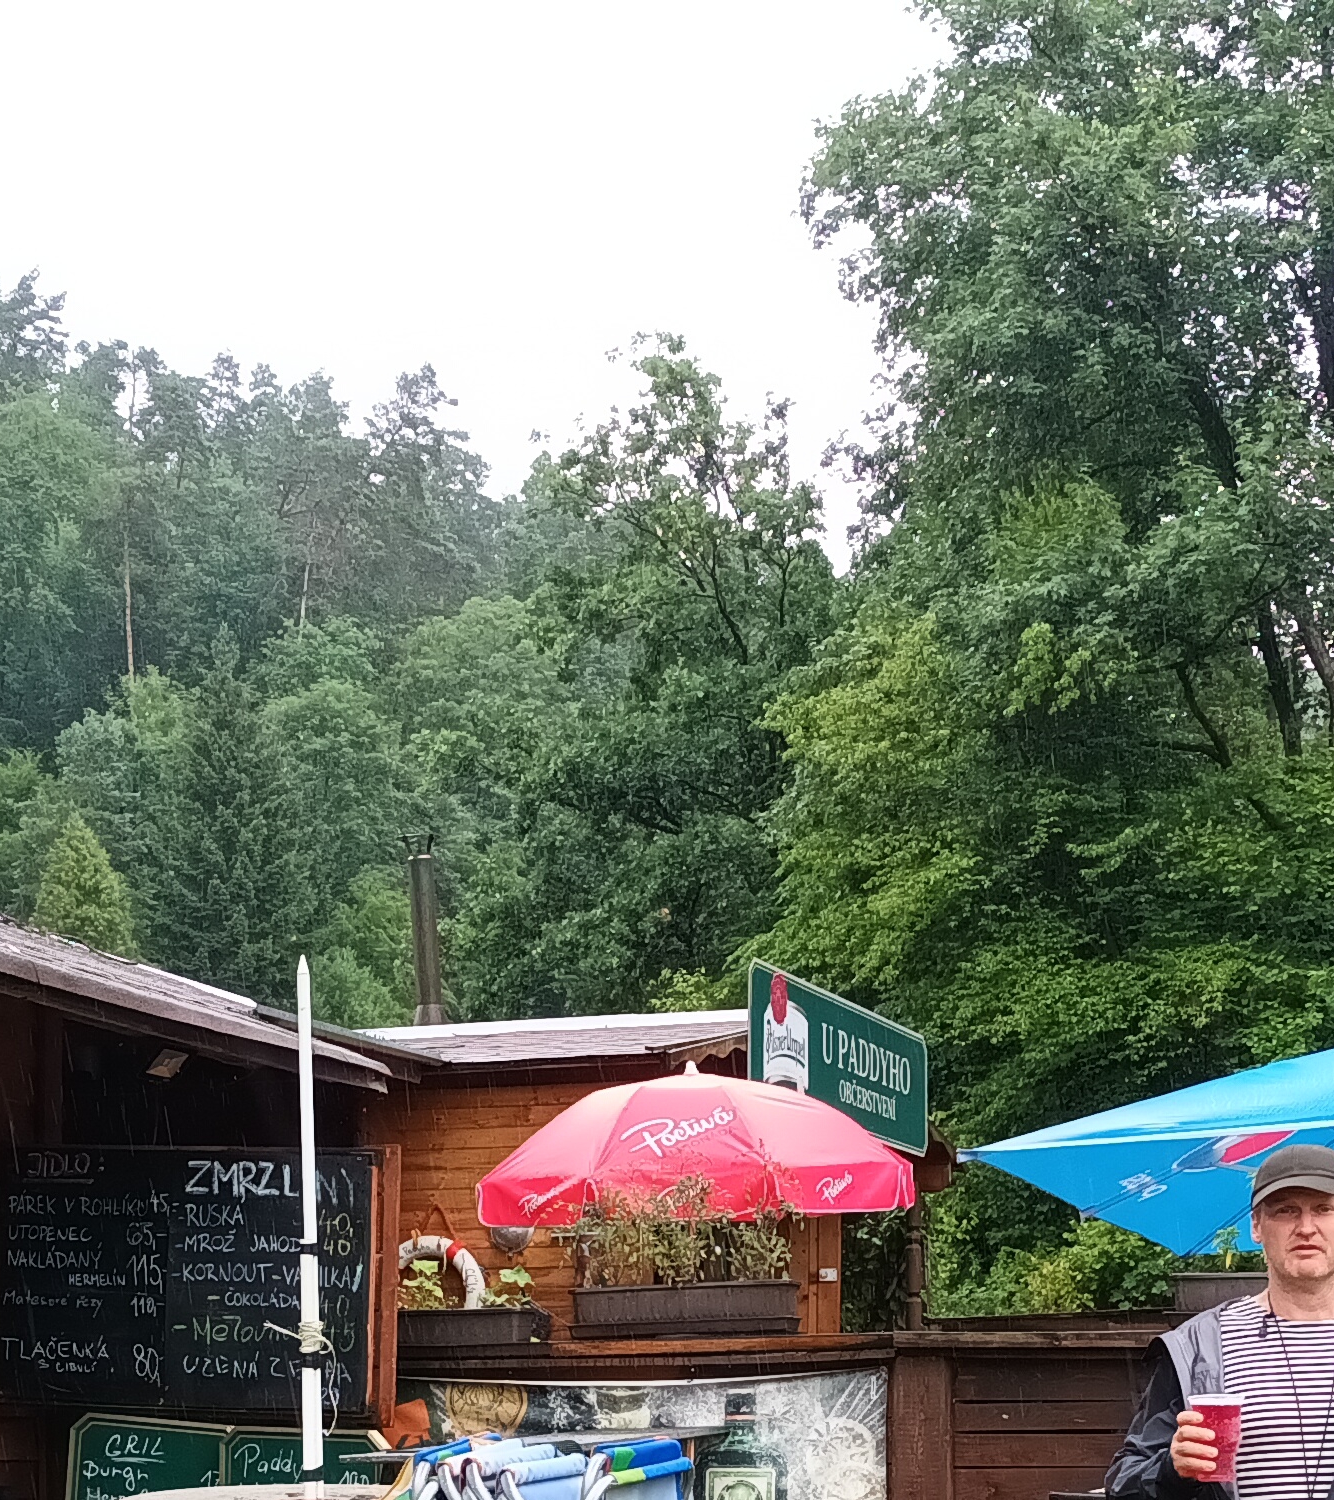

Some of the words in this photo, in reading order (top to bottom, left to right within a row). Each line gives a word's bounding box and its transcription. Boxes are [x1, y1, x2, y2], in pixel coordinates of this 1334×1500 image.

[821, 1023, 834, 1065] U
[837, 1029, 911, 1095] PADDYHO
[839, 1079, 897, 1121] OBČERSTVENÍ
[620, 1106, 734, 1158] Poctivá
[9, 1224, 92, 1242] UTOPENEC
[7, 1241, 103, 1269] NAKLÁDANÝ
[68, 1268, 126, 1287] HERMELÍN
[105, 1434, 165, 1457] GRIL
[234, 1443, 304, 1484] Paddy
